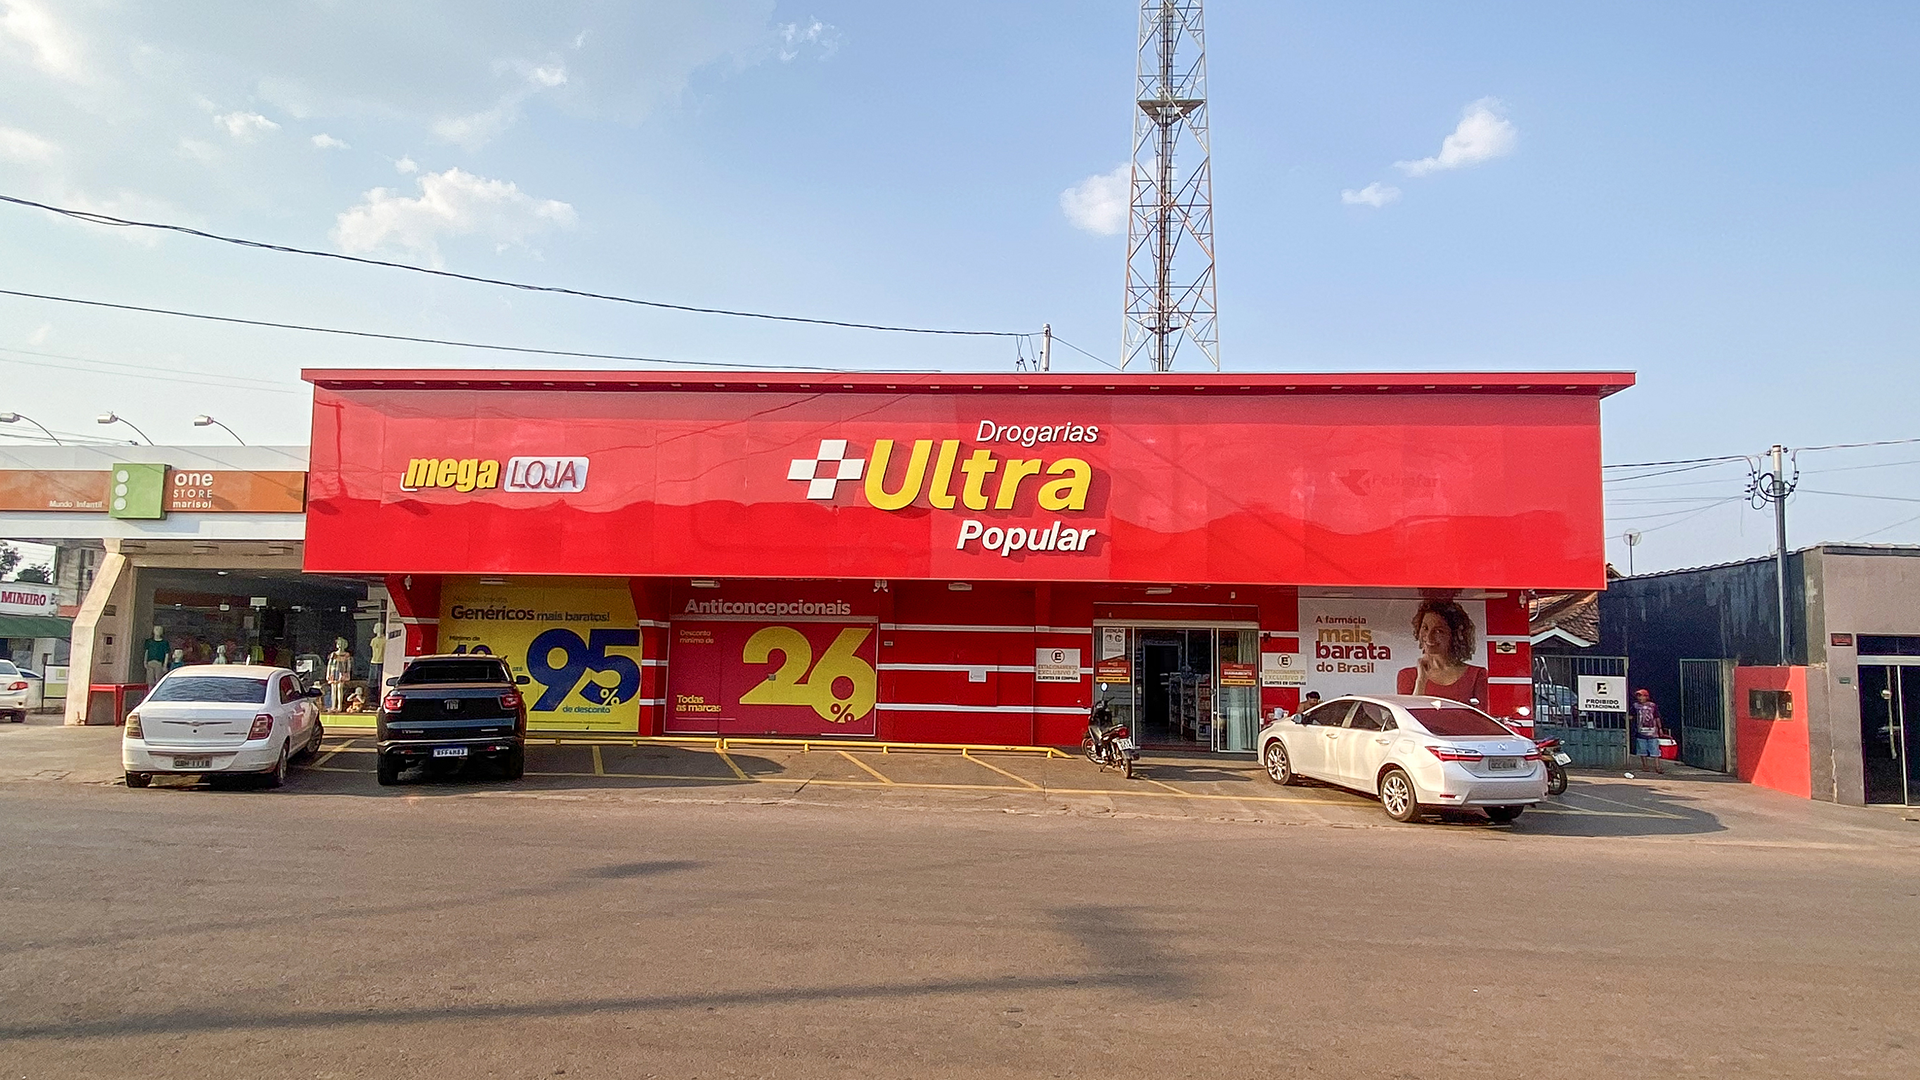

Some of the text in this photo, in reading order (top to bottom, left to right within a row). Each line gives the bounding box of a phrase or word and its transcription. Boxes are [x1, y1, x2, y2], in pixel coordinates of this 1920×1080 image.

[976, 420, 1099, 447] Drogarias
[174, 471, 214, 487] one
[404, 458, 577, 492] mega LOJA
[864, 439, 1092, 511] Ultra
[173, 489, 213, 499] STORE
[50, 500, 103, 509] Mundo Infantil
[173, 500, 212, 509] marisol
[956, 520, 1096, 557] Popular
[451, 605, 610, 622] Genéricos mais baratos!
[684, 599, 851, 616] Anticoncepcionais
[1315, 615, 1367, 624] A farmácia
[1318, 626, 1372, 643] mais
[1315, 641, 1391, 660] barata
[1316, 661, 1374, 673] do Brasil
[677, 694, 704, 704] Todas
[562, 705, 611, 714] de desconto
[676, 703, 721, 712] as marcas
